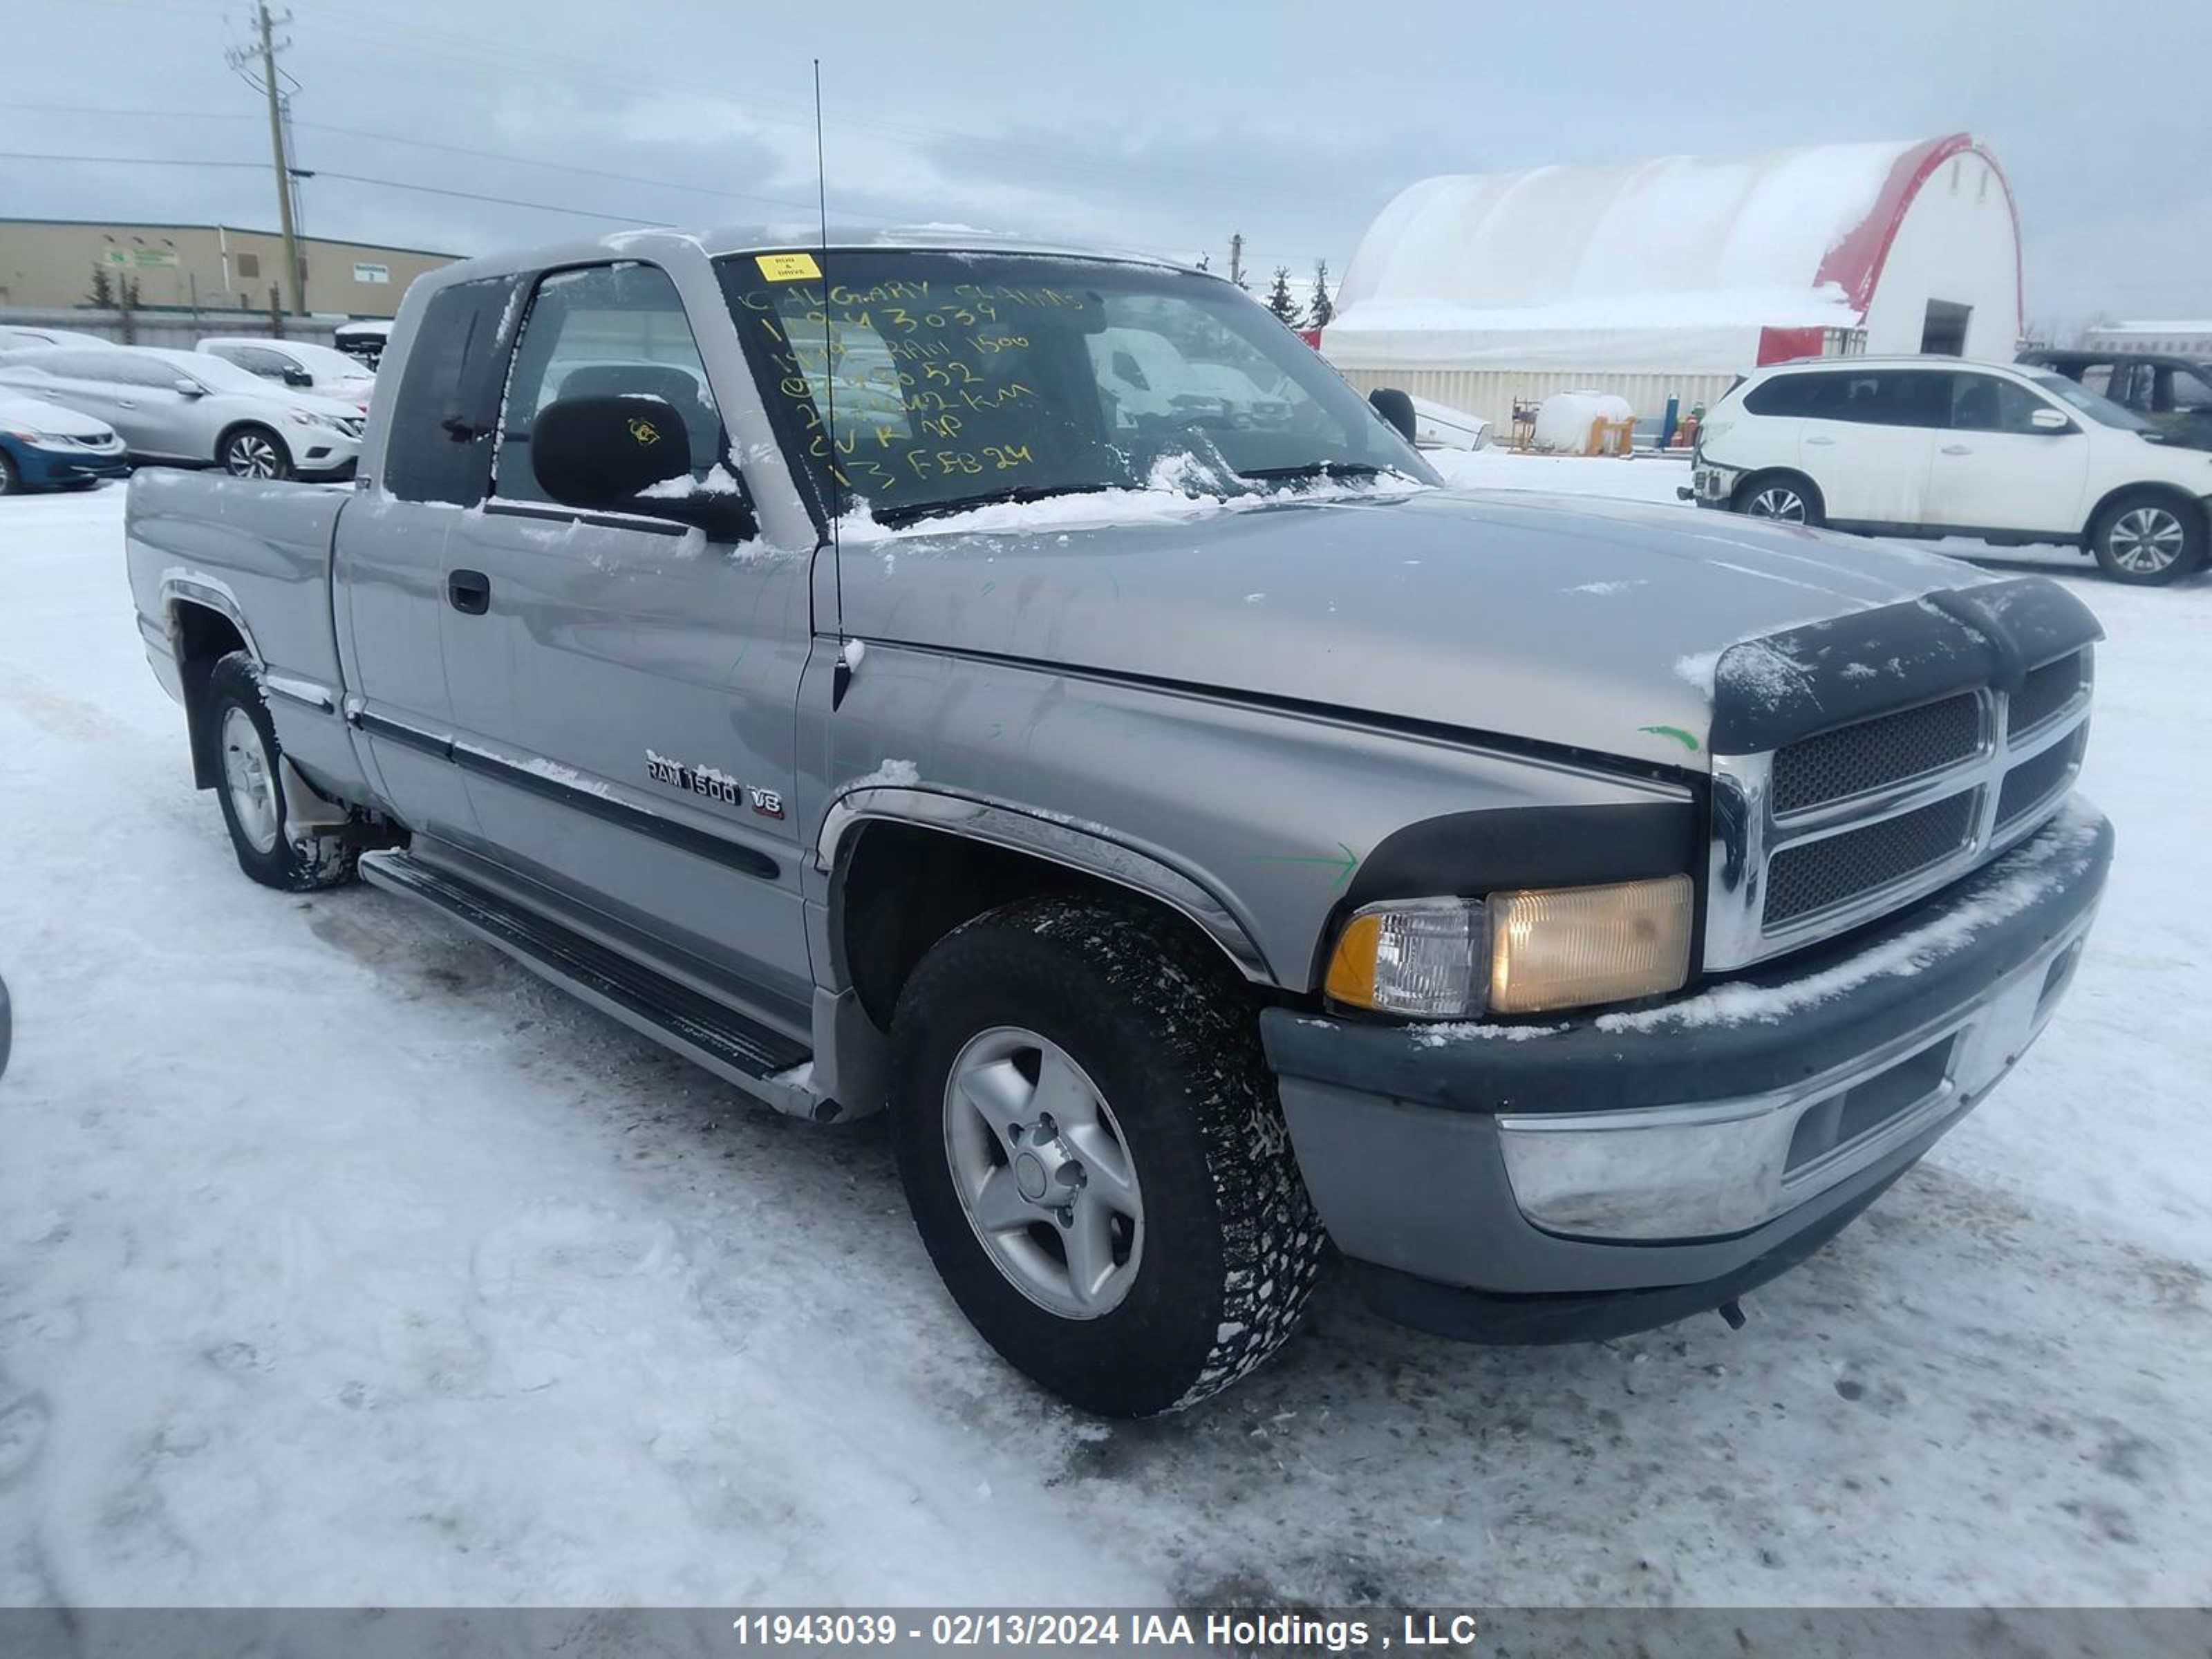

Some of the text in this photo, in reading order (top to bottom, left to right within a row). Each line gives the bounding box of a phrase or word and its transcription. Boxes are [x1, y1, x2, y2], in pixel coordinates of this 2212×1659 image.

[738, 281, 928, 310] CALGARY
[907, 449, 983, 480] FEB
[646, 760, 682, 789] RAM
[684, 769, 738, 807] 1500
[750, 789, 782, 813] V8
